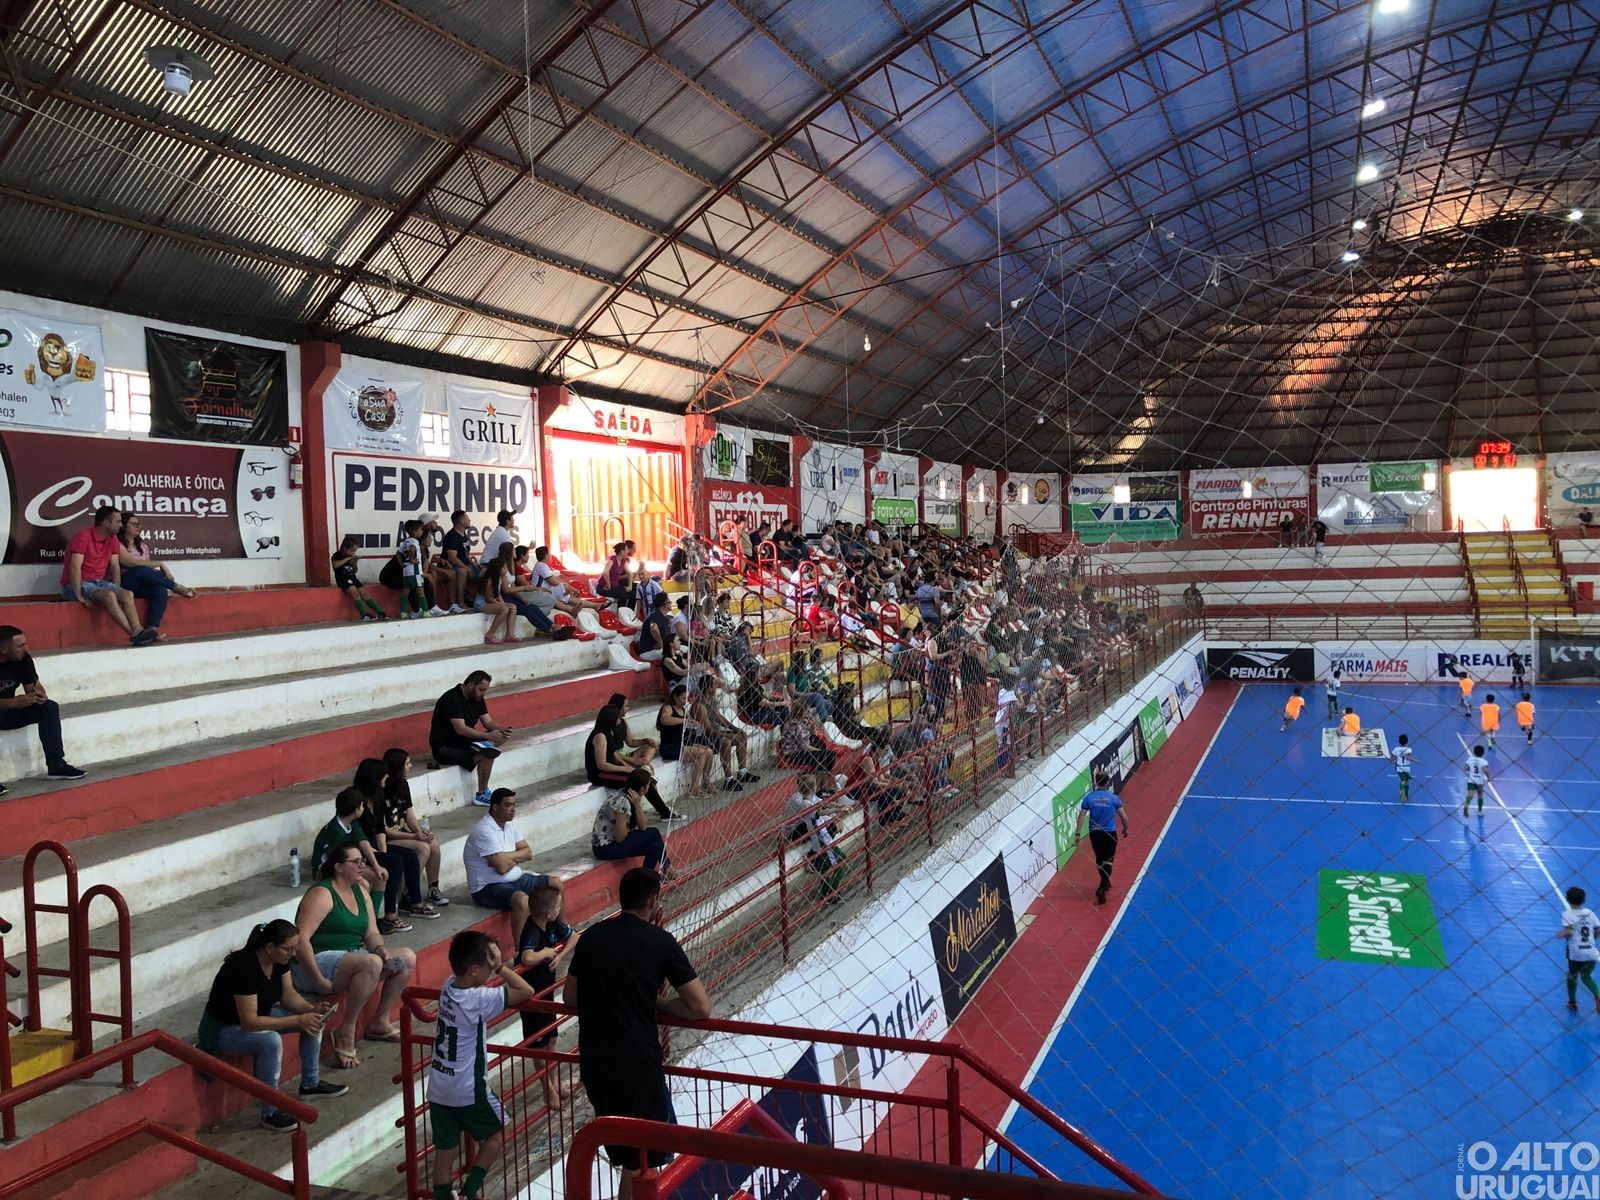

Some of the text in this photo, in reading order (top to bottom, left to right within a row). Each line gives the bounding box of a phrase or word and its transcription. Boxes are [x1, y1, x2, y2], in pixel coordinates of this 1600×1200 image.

[0, 392, 28, 403] halen
[364, 409, 386, 421] Casa
[594, 408, 653, 435] SADA
[462, 418, 522, 446] GRILL
[122, 473, 226, 490] JOALHERIA E ÓTICA
[1195, 479, 1243, 490] MARION
[1332, 474, 1369, 483] REALIZE
[345, 463, 527, 514] PEDRINHO
[25, 476, 228, 528] Confiança
[1191, 499, 1309, 513] Centro de Pinturas
[877, 506, 893, 518] FOTO
[1089, 502, 1178, 528] VIDA
[153, 530, 176, 541] 1412
[40, 549, 57, 557] Rua
[153, 546, 222, 556] Frederico Westphalen
[1460, 653, 1533, 667] REALIE
[1230, 667, 1291, 679] PENALTY
[946, 882, 1003, 972] Marathon
[1347, 893, 1412, 959] Sicredi
[435, 1017, 458, 1062] 21
